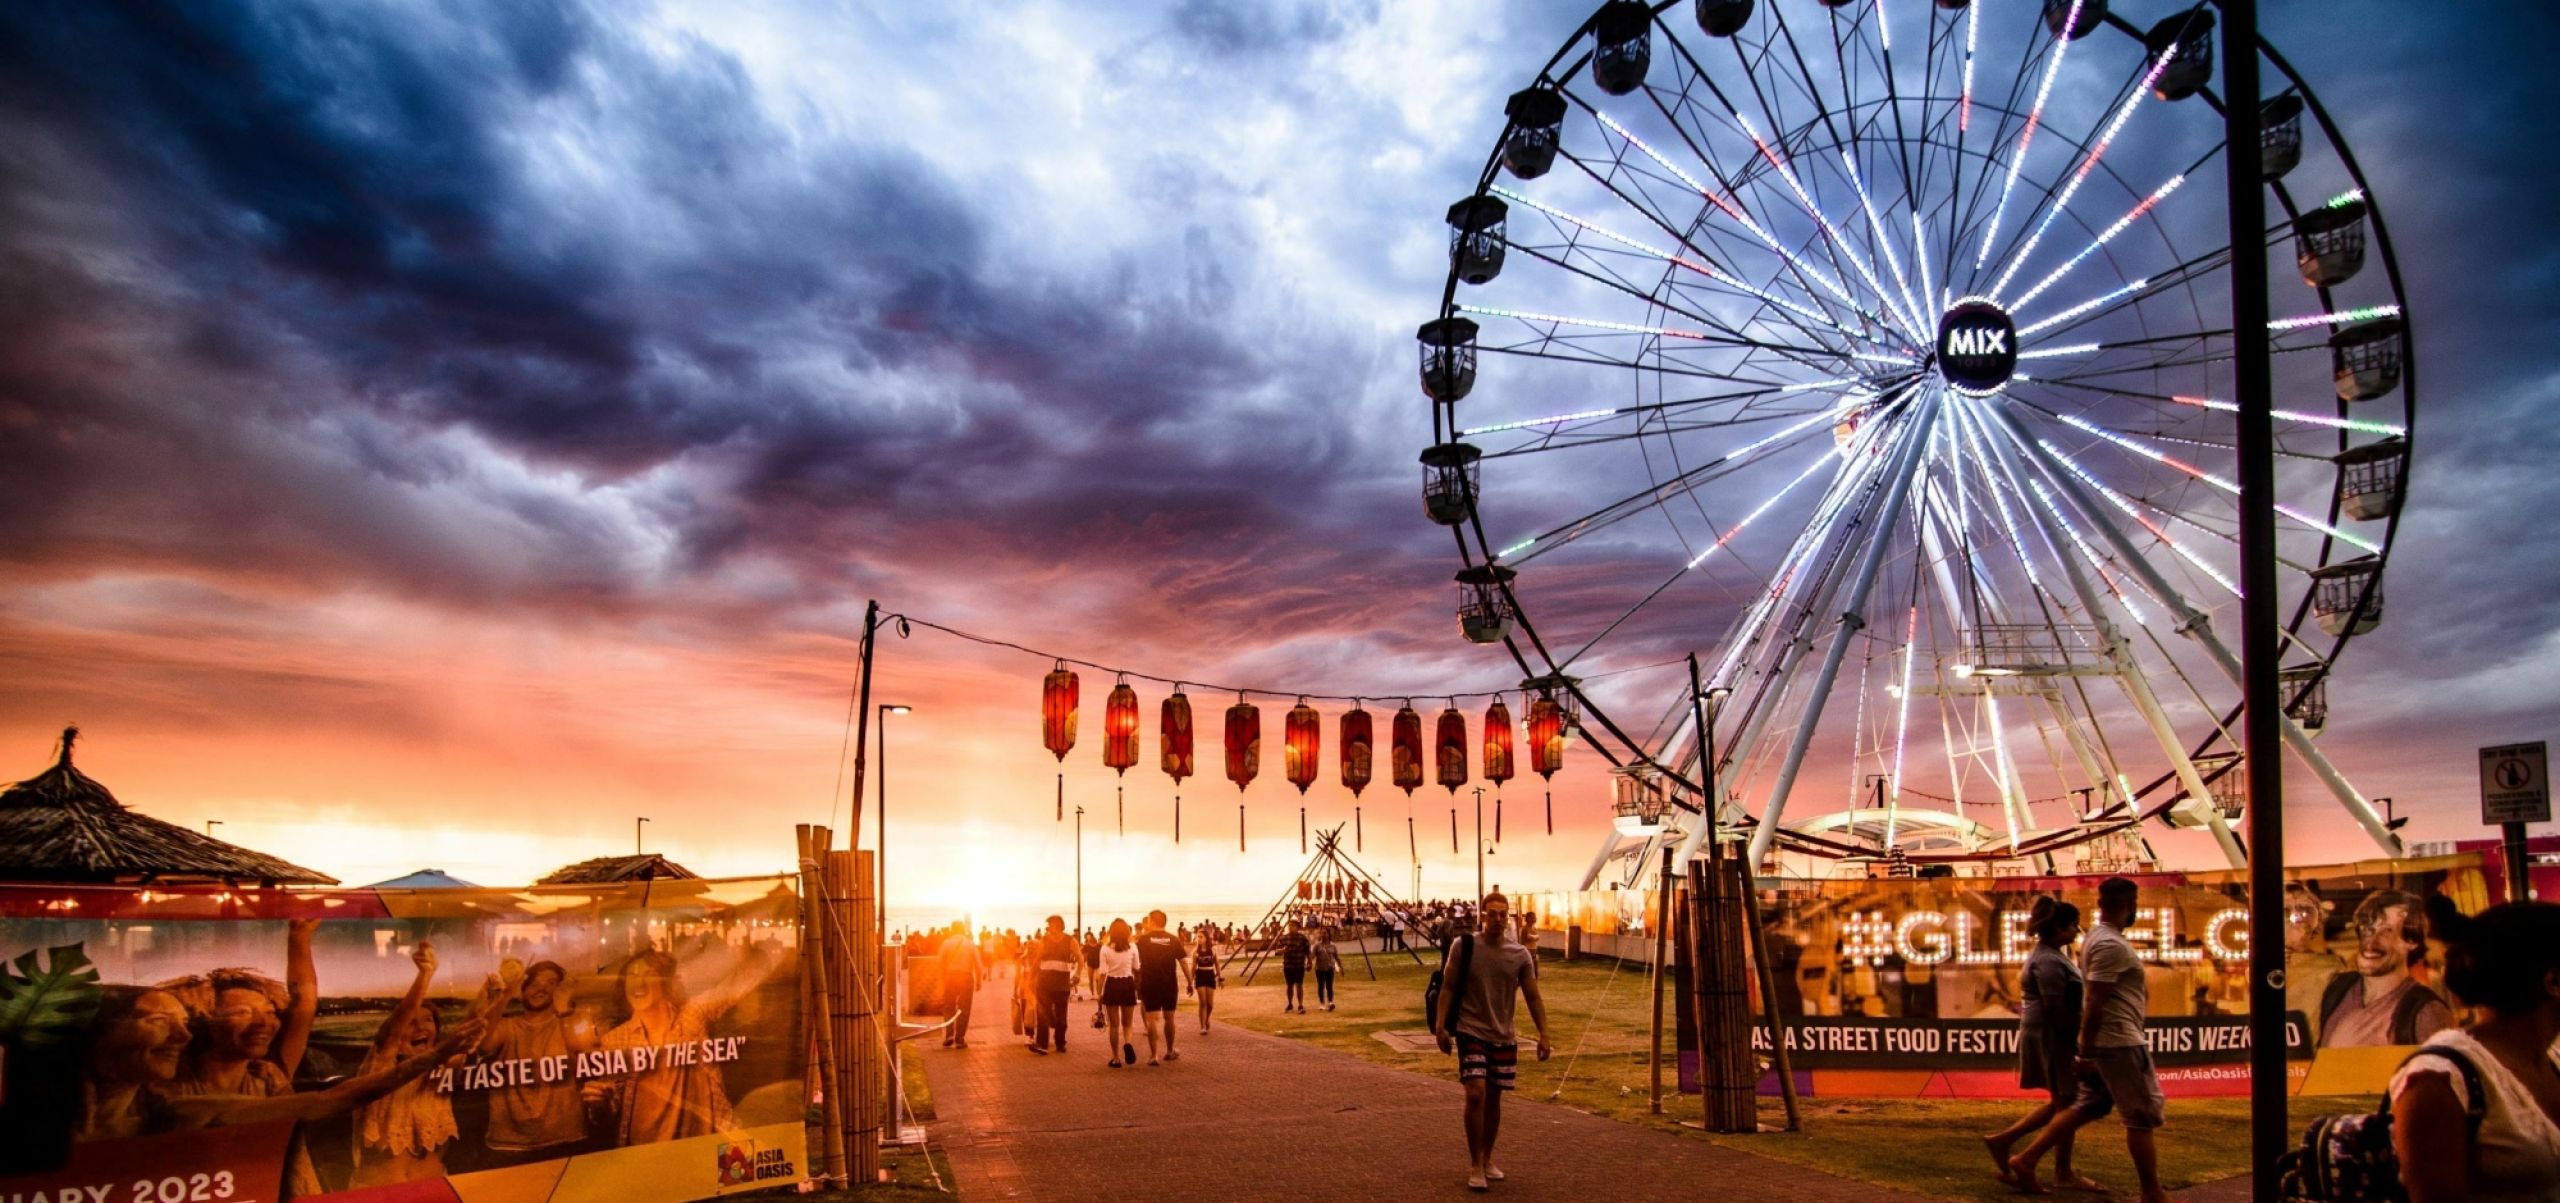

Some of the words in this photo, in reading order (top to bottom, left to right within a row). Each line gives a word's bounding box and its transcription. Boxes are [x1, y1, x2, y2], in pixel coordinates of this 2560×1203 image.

[1948, 328, 2007, 355] MIX
[1841, 909, 2249, 966] #GLEELG
[1751, 1026, 1798, 1050] ASA
[1802, 1026, 1880, 1051] STREET
[1885, 1027, 1941, 1053] FOOD
[1946, 1028, 2021, 1054] FESTIV
[2144, 1027, 2193, 1053] THIS
[2199, 1022, 2301, 1051] WEEKD
[464, 1056, 535, 1091] TASTE
[540, 1053, 568, 1082] OF
[576, 1048, 628, 1079] ASIA
[632, 1046, 660, 1073] BY
[664, 1040, 697, 1068] THE
[756, 1148, 784, 1166] ASIA
[756, 1162, 795, 1180] OASIS
[132, 1170, 235, 1203] 2023
